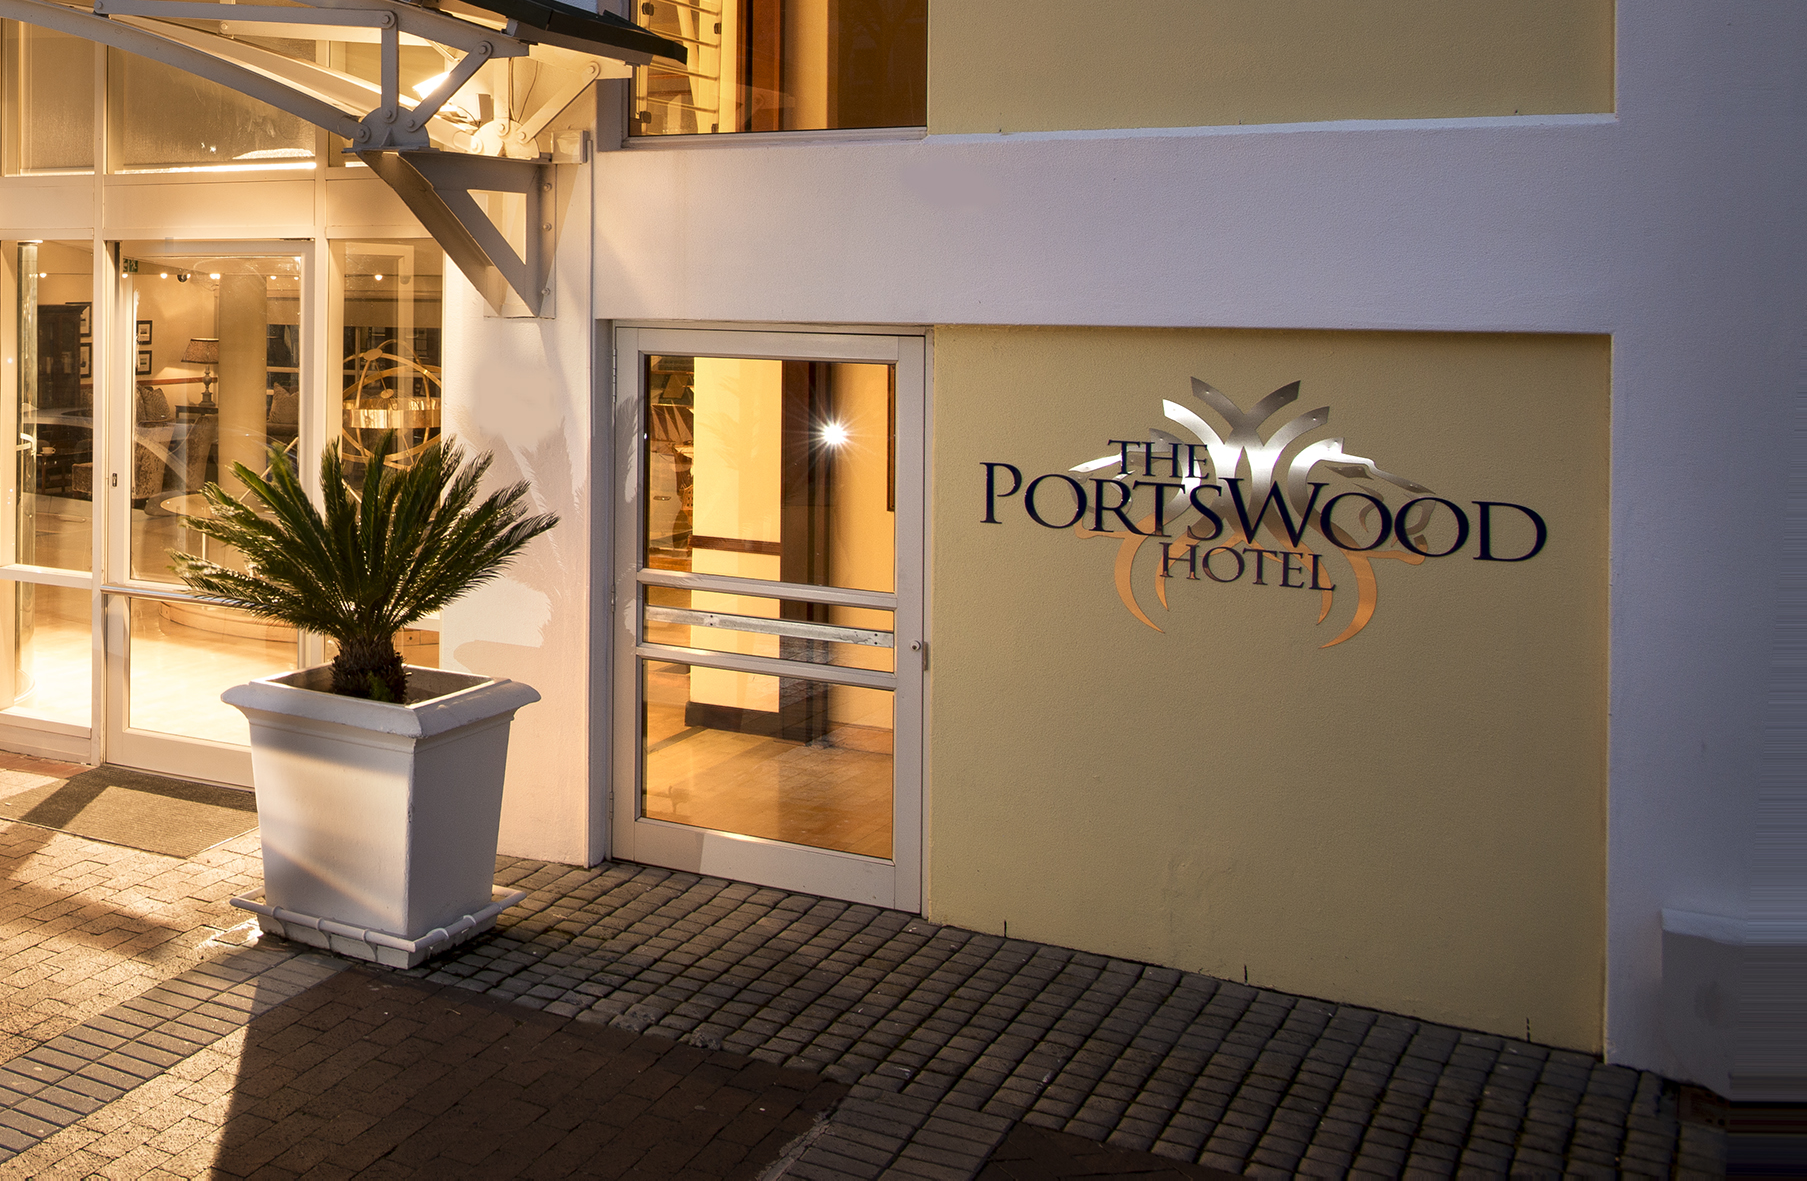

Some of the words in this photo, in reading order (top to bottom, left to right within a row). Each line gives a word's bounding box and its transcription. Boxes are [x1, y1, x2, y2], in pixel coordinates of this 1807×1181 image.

[1108, 439, 1210, 479] THE
[979, 461, 1547, 562] PORTSWOOD
[1159, 541, 1336, 592] HOTEL
